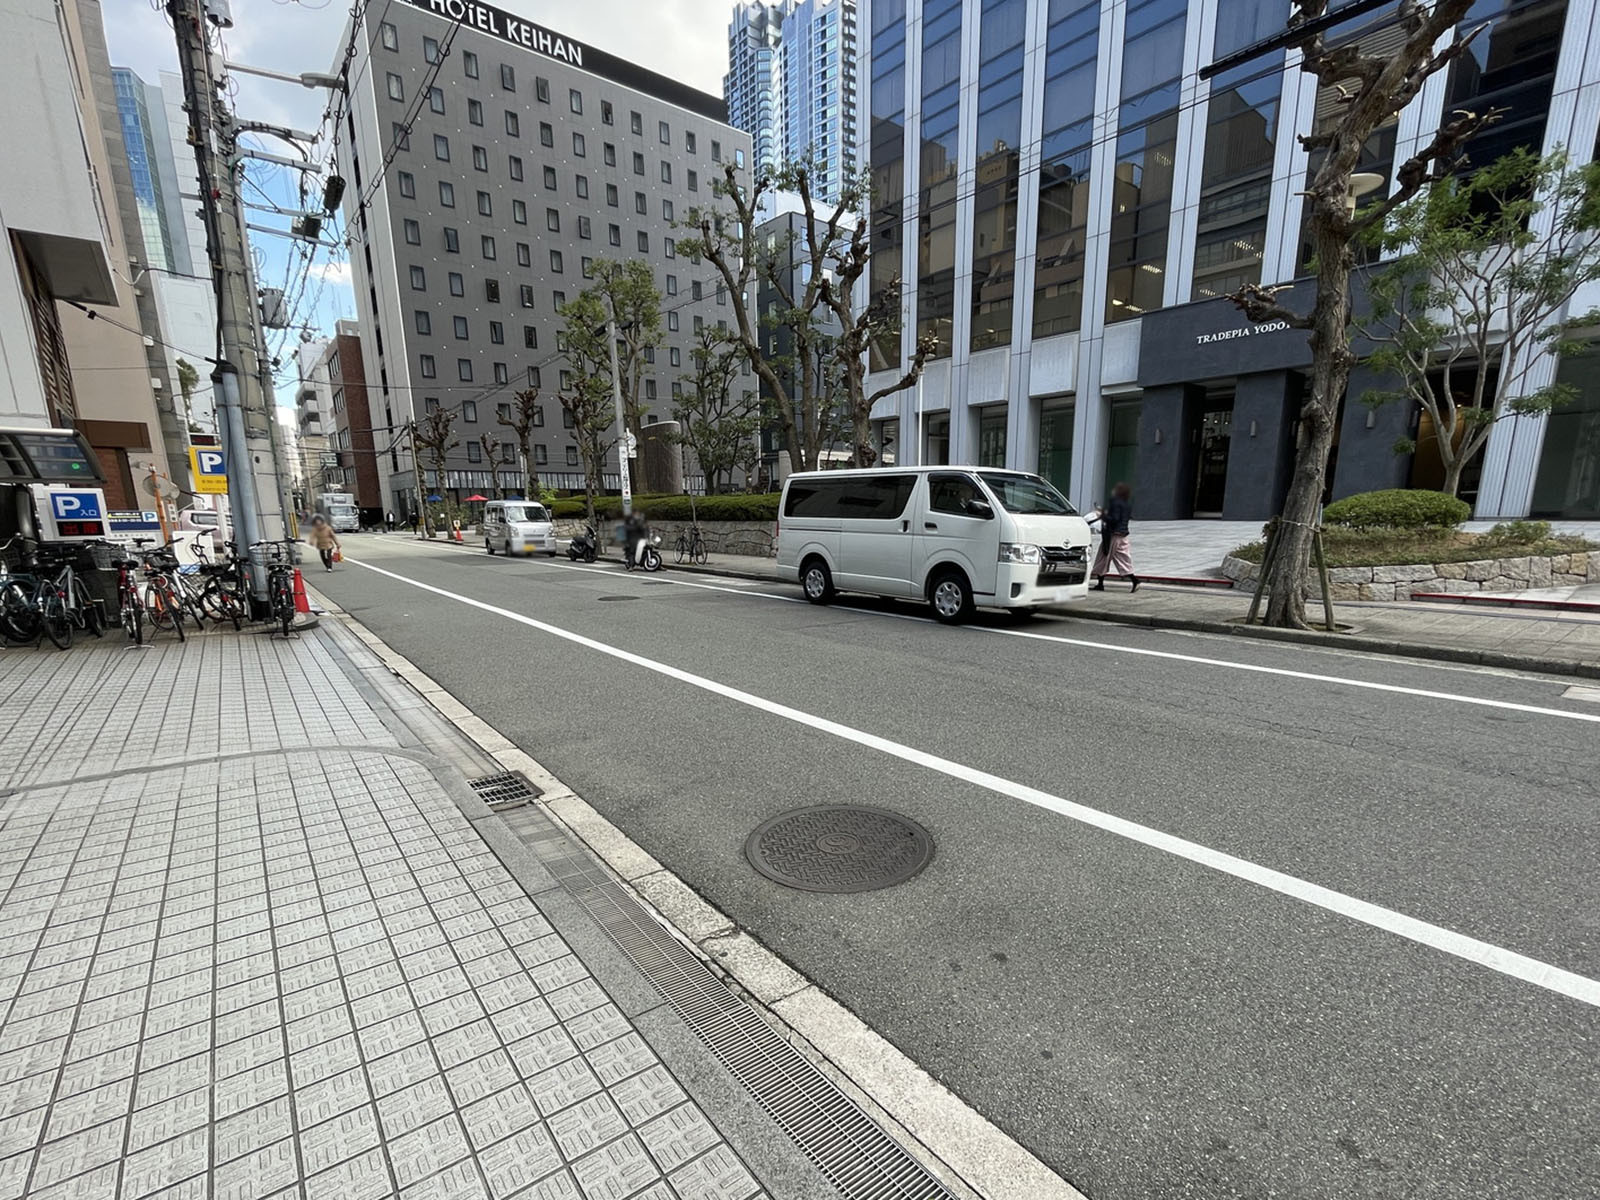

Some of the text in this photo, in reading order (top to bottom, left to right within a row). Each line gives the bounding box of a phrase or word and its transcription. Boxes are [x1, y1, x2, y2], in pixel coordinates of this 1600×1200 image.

[430, 0, 583, 66] HOTEL KEIHAN
[1196, 321, 1290, 344] TRADEPIA YODO
[201, 453, 222, 472] P
[55, 496, 80, 516] P
